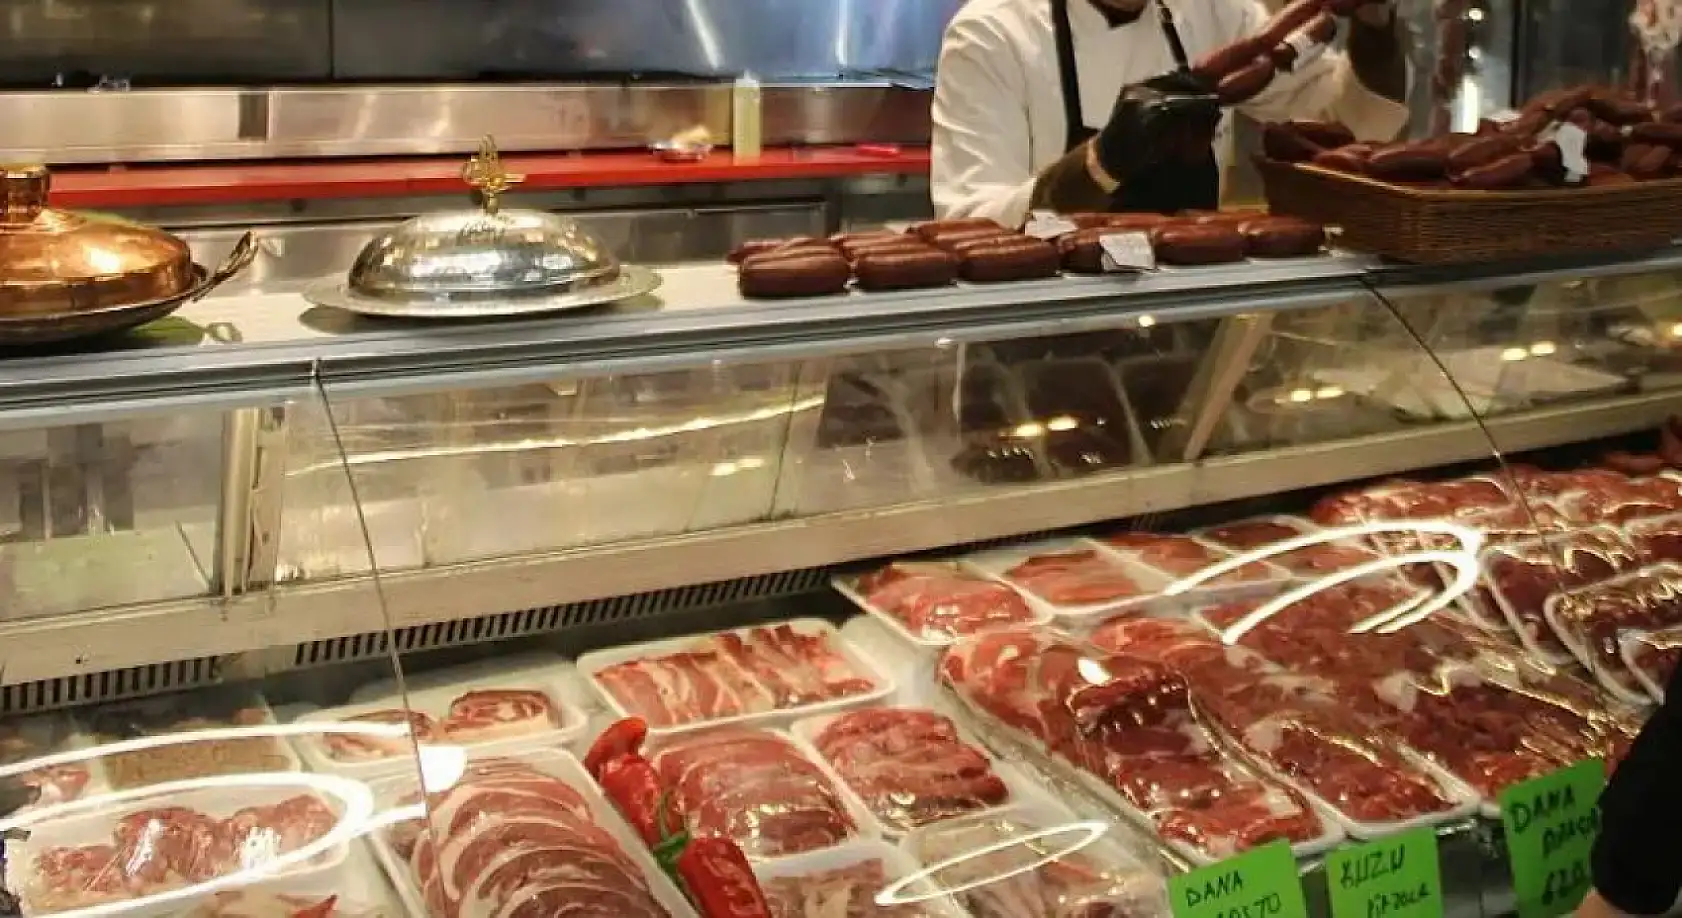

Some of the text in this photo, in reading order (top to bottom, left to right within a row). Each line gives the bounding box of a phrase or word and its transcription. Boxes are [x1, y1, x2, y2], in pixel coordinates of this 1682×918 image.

[1509, 784, 1576, 834] DANA
[1186, 869, 1243, 908] DANA
[1341, 843, 1405, 889] KUZU
